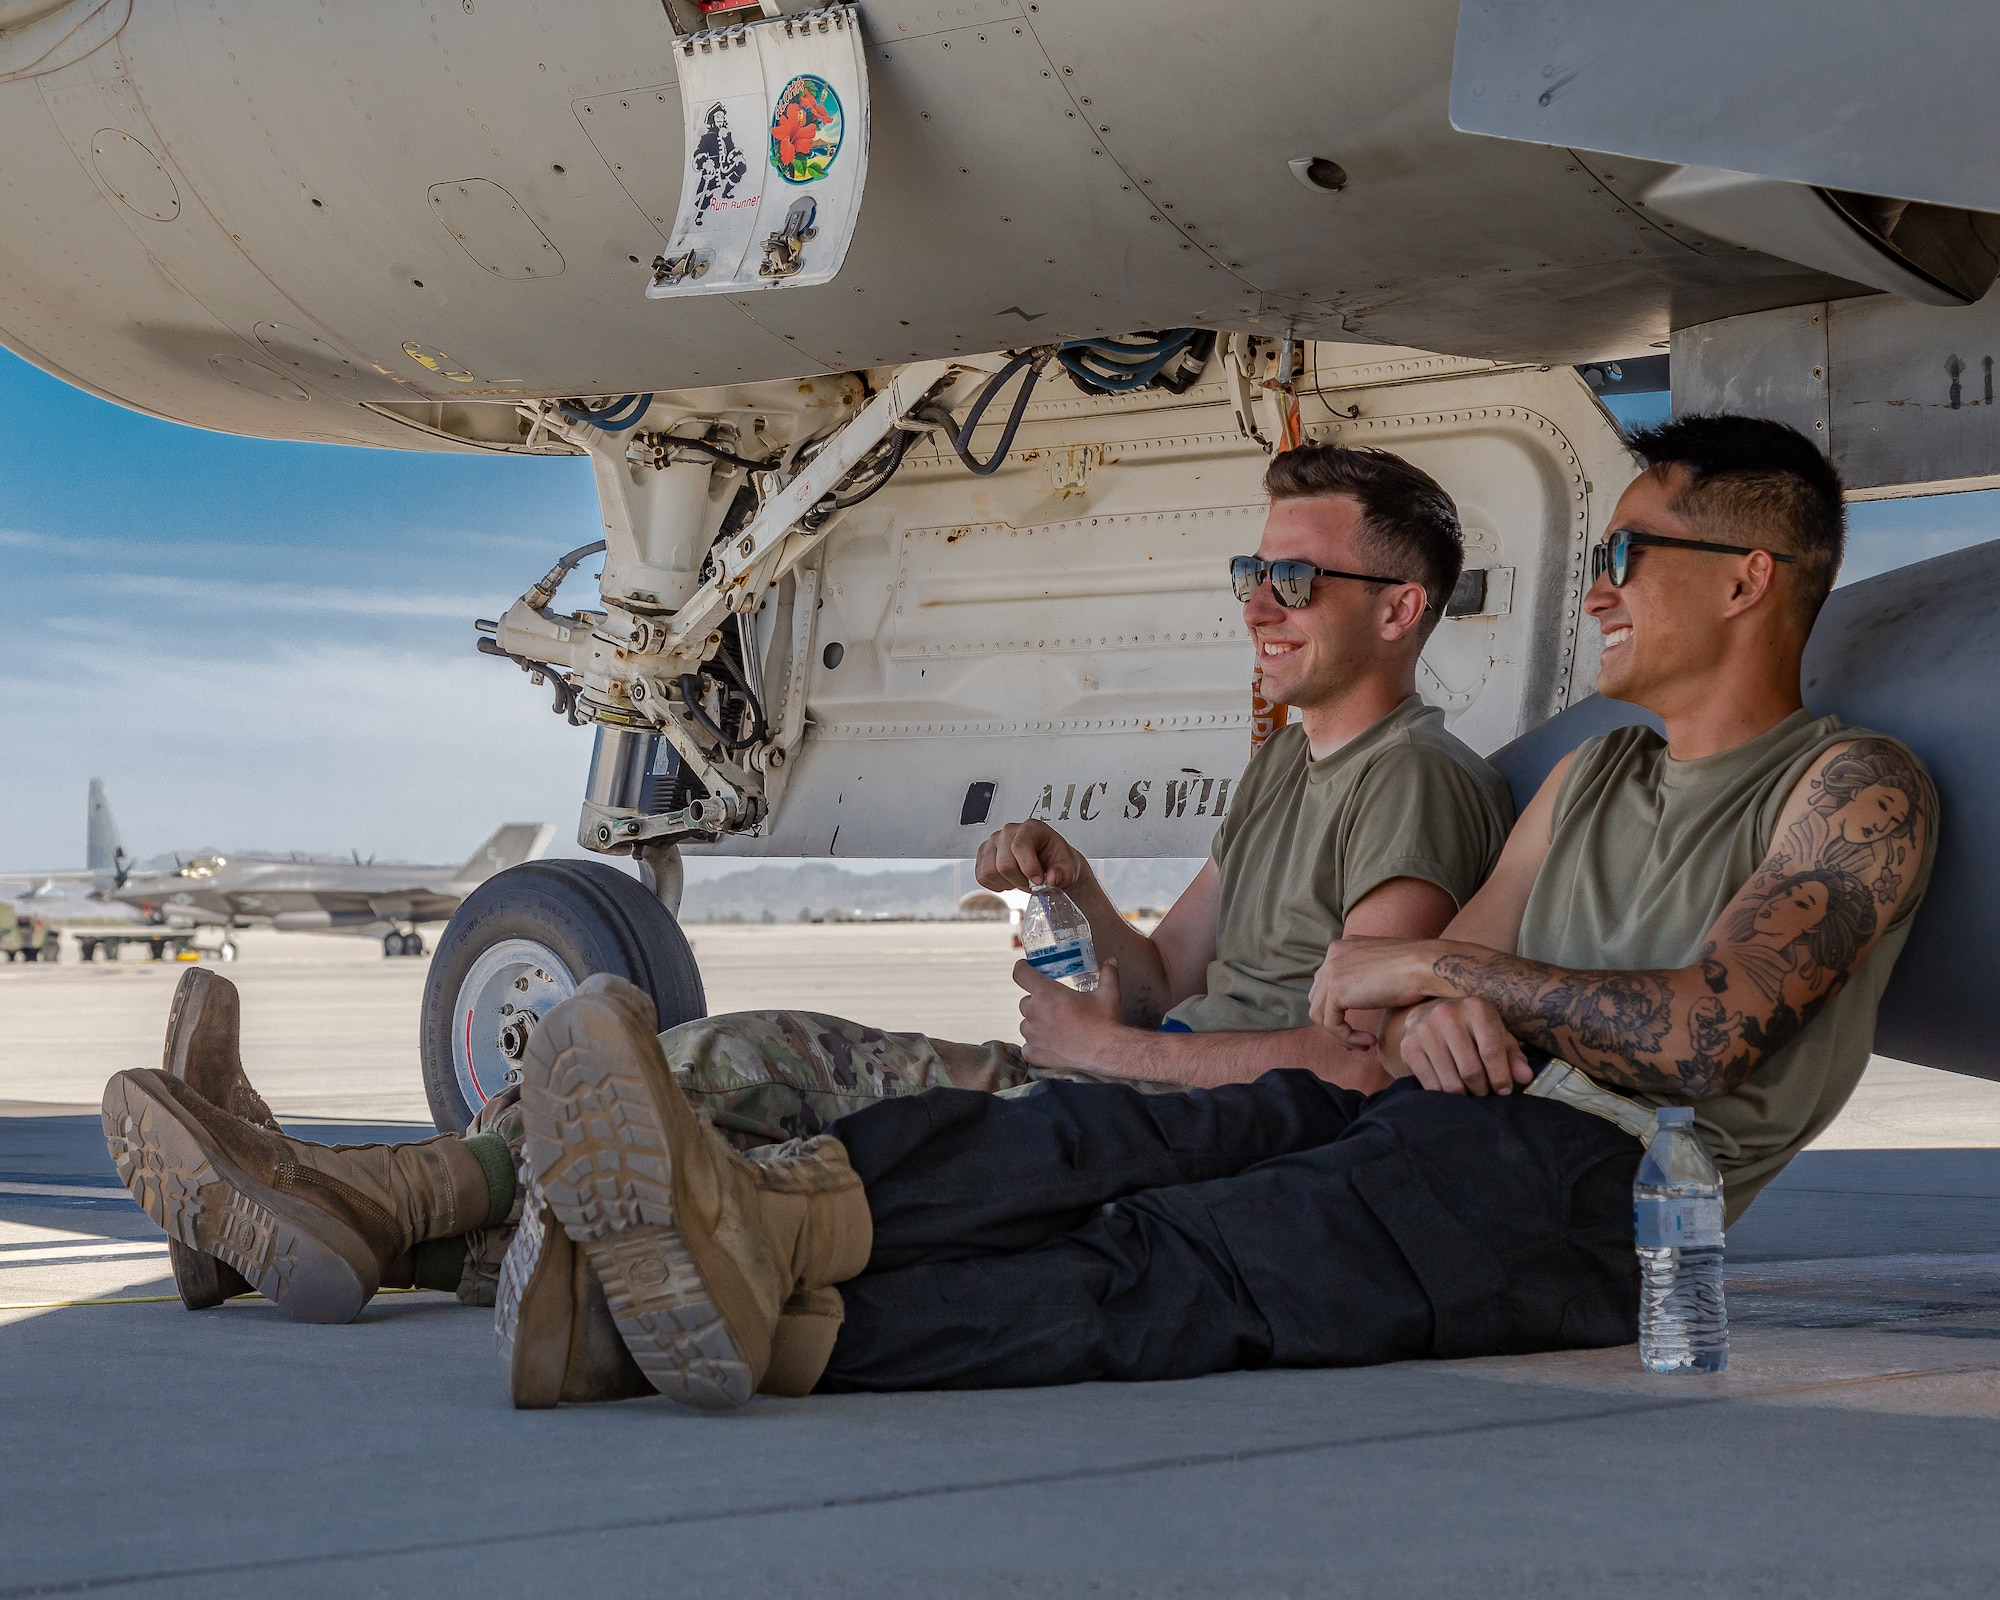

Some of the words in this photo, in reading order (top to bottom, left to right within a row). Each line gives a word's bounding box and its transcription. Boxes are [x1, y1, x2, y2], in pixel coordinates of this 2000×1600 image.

[776, 77, 804, 119] ALOHA
[710, 197, 728, 211] Rum
[731, 195, 760, 209] Runner
[1123, 780, 1151, 820] S
